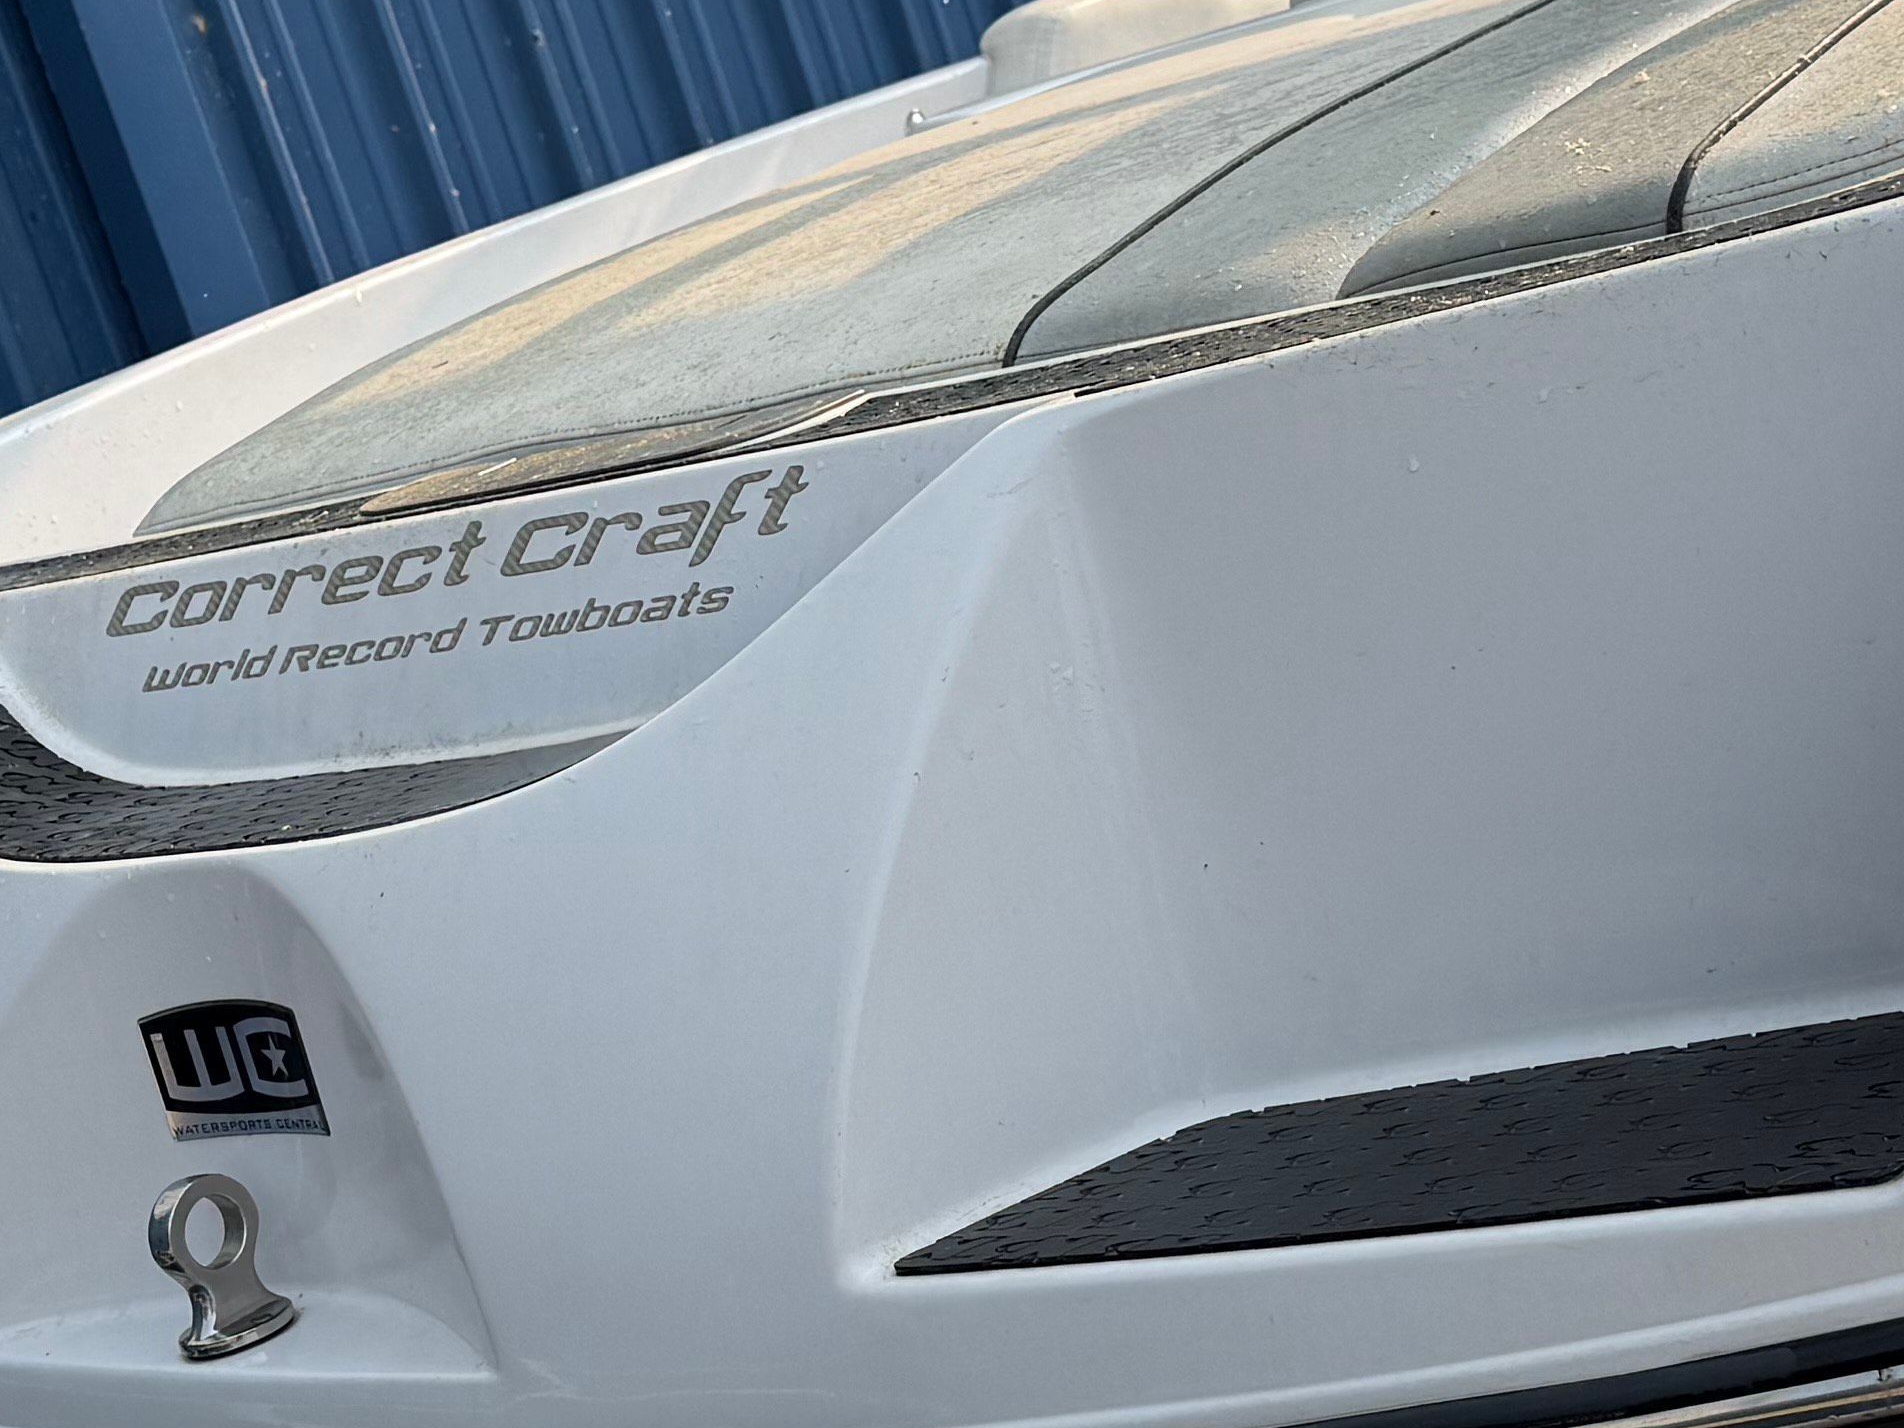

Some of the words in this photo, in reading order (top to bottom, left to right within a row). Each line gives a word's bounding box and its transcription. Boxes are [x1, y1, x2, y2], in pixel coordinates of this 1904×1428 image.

[105, 520, 487, 638] Correct
[500, 464, 810, 577] Craft
[279, 617, 468, 675] Record
[481, 581, 734, 646] Towboats
[174, 1118, 272, 1137] WATERSPORTS
[276, 1118, 326, 1132] CENTRAL
